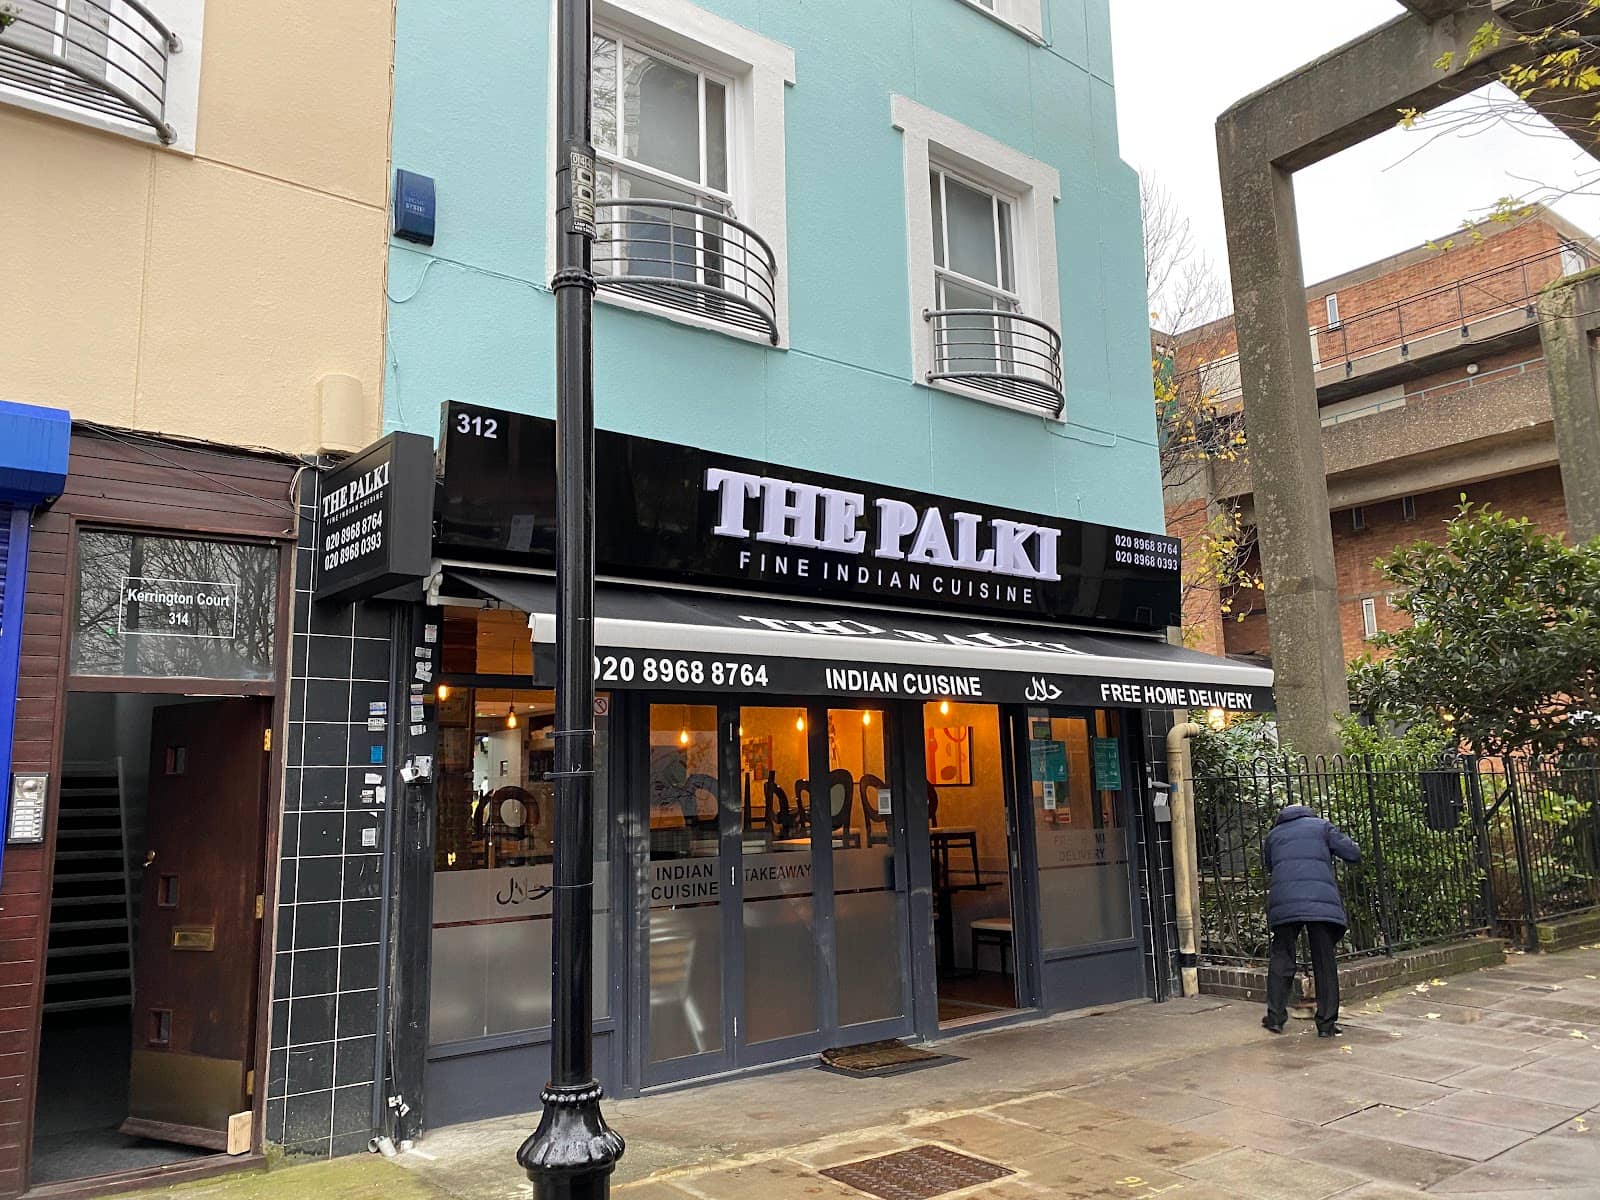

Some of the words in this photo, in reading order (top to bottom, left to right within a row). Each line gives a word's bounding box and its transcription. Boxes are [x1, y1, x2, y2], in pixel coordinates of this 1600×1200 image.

[456, 413, 498, 439] 312
[322, 485, 348, 518] THE
[348, 461, 391, 505] PALKI
[326, 514, 339, 526] FINE
[339, 503, 359, 519] INDIAN
[359, 490, 384, 509] CUISINE
[325, 531, 340, 552] 020
[340, 521, 361, 545] 8968
[361, 509, 383, 535] 8764
[705, 467, 867, 554] THE
[873, 498, 1062, 582] PALKI
[324, 550, 339, 571] 020
[339, 541, 360, 565] 8968
[360, 531, 382, 556] 0393
[1115, 534, 1132, 548] 020
[1133, 537, 1155, 552] 8968
[1157, 541, 1178, 555] 8764
[1115, 550, 1132, 564] 020
[1134, 553, 1155, 567] 8968
[1157, 556, 1178, 571] 0393
[739, 551, 809, 577] FINE
[823, 562, 920, 591] INDIAN
[932, 576, 1033, 604] CUISINE
[127, 588, 194, 606] Kerrington
[196, 592, 230, 607] Court
[168, 612, 189, 626] 314
[642, 657, 705, 685] 8968
[710, 661, 769, 687] 8764
[825, 667, 898, 693] INDIAN
[902, 673, 982, 697] CUISINE
[1024, 675, 1063, 702] حلال
[1100, 683, 1142, 703] FREE
[1144, 686, 1187, 706] HOME
[1188, 689, 1254, 710] DELIVERY
[656, 863, 713, 881] INDIAN
[744, 864, 812, 882] TAKEAWAY
[651, 881, 719, 900] CUISINE
